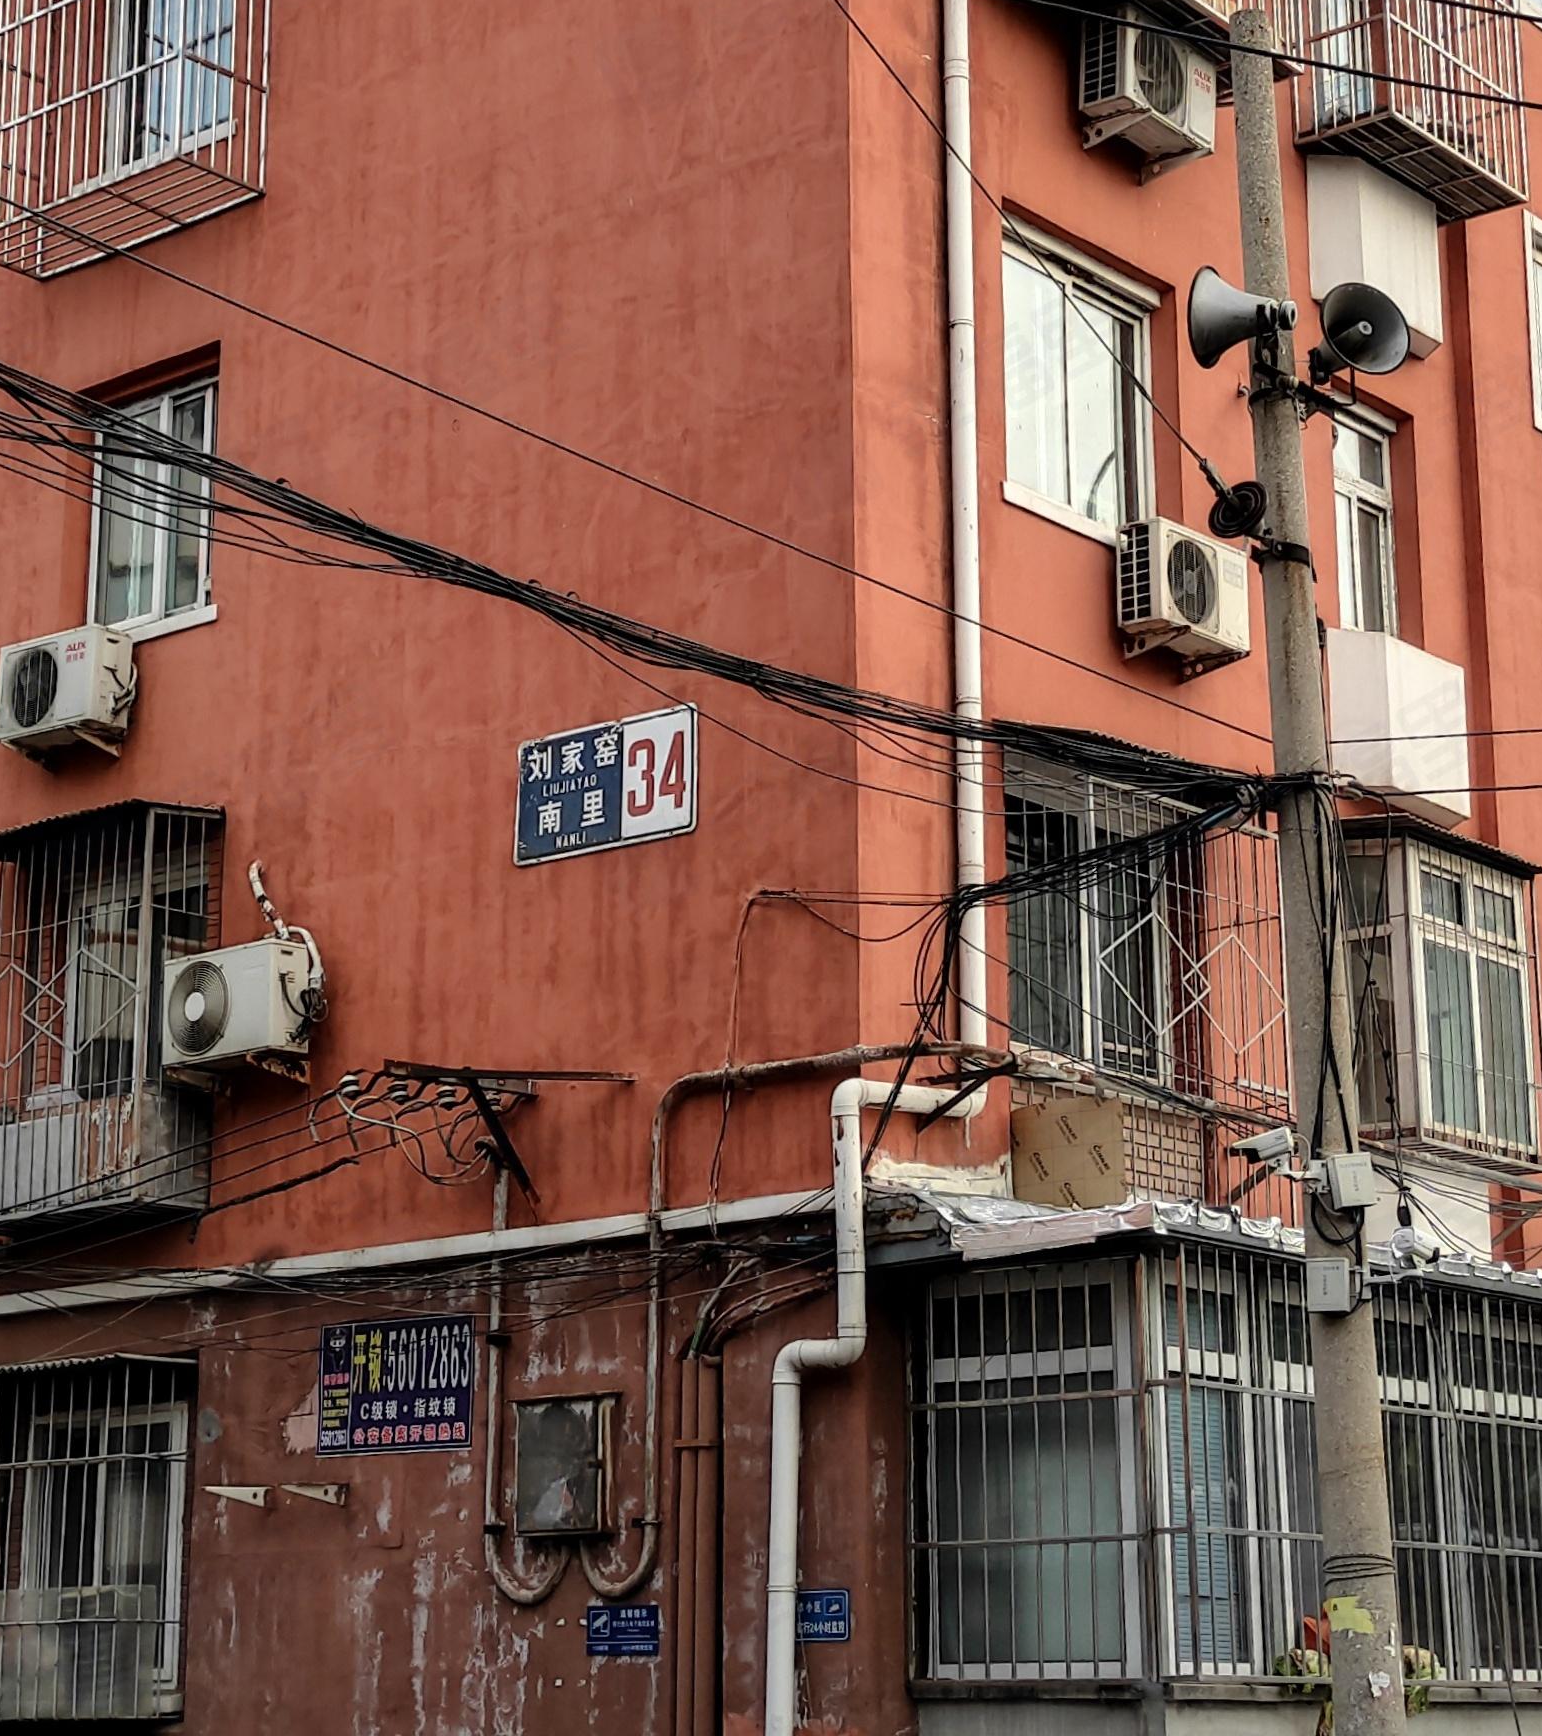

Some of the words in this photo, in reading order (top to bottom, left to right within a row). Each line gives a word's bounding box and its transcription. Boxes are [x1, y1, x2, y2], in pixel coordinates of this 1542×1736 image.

[527, 733, 619, 783] 刘家窑
[627, 730, 687, 818] 34
[542, 774, 598, 798] LIUJIAYAO
[537, 790, 605, 836] 南里
[555, 832, 587, 849] NANLI
